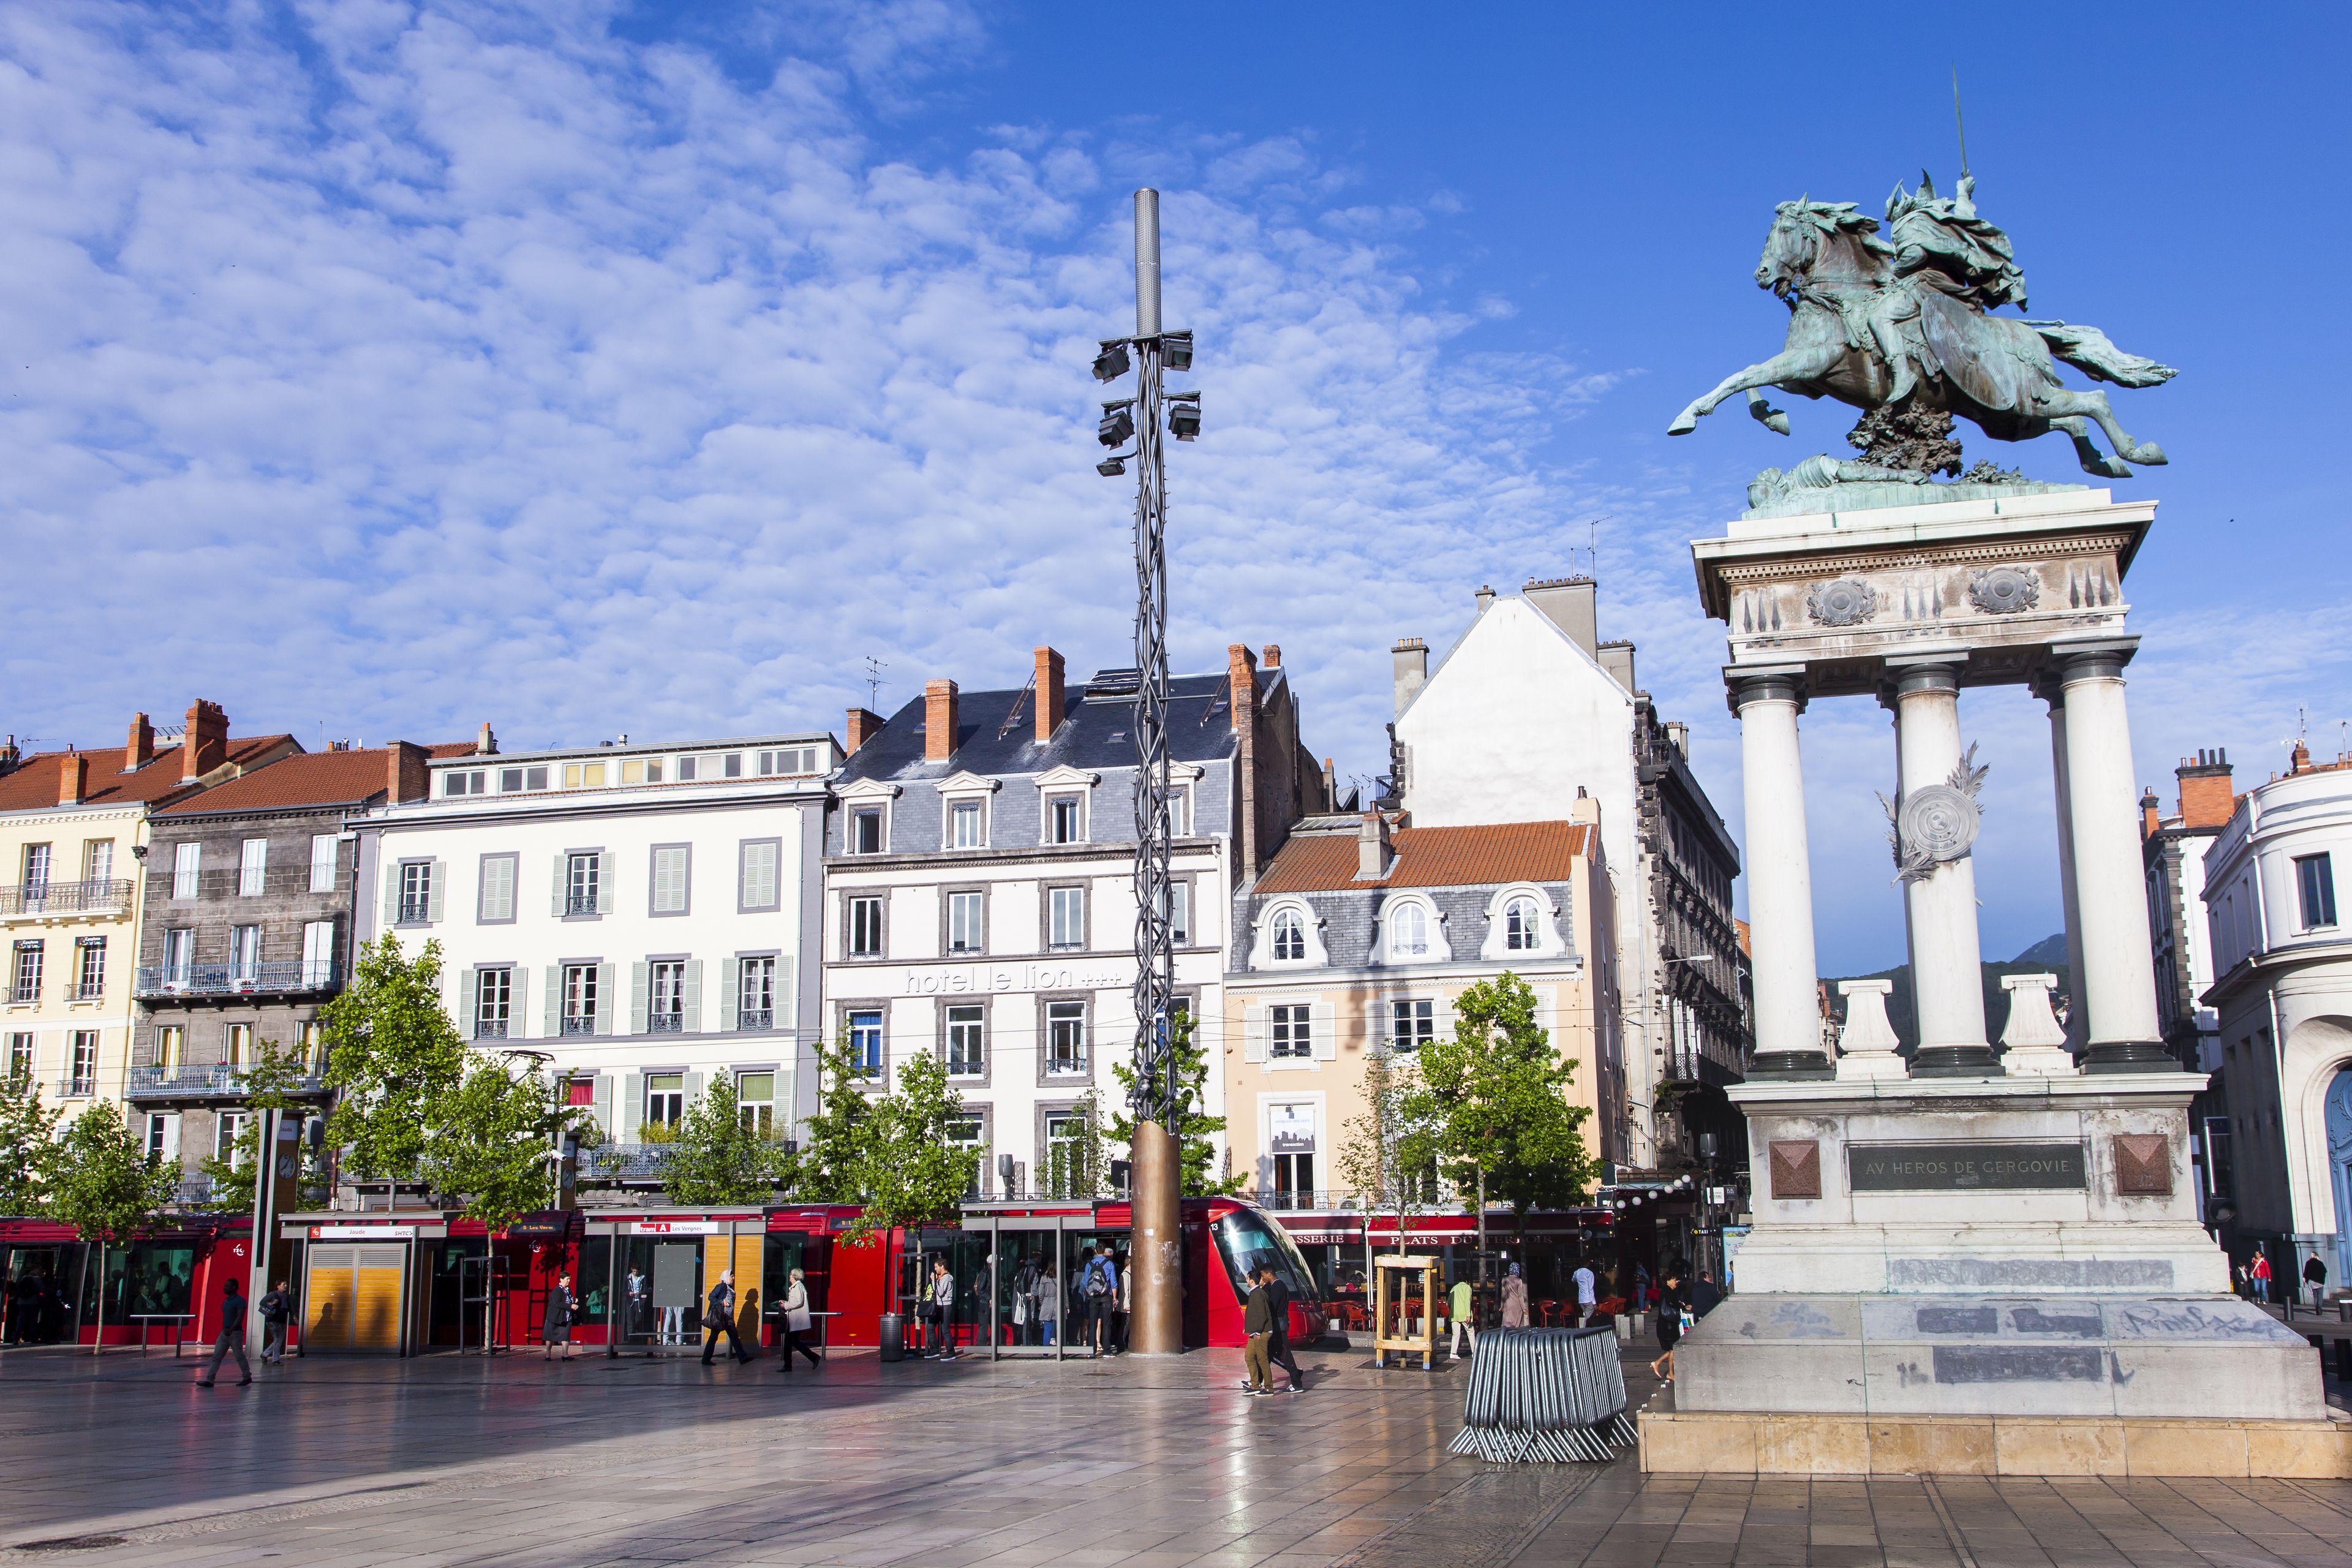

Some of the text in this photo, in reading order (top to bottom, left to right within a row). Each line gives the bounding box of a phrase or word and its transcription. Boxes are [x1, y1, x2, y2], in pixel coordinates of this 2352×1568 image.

[906, 967, 974, 993] hotel
[987, 966, 1011, 990] le
[1023, 964, 1072, 989] lion
[1866, 1160, 2070, 1175] AV HEROS DE GERGOVIE
[1485, 1235, 1553, 1244] TEROIR
